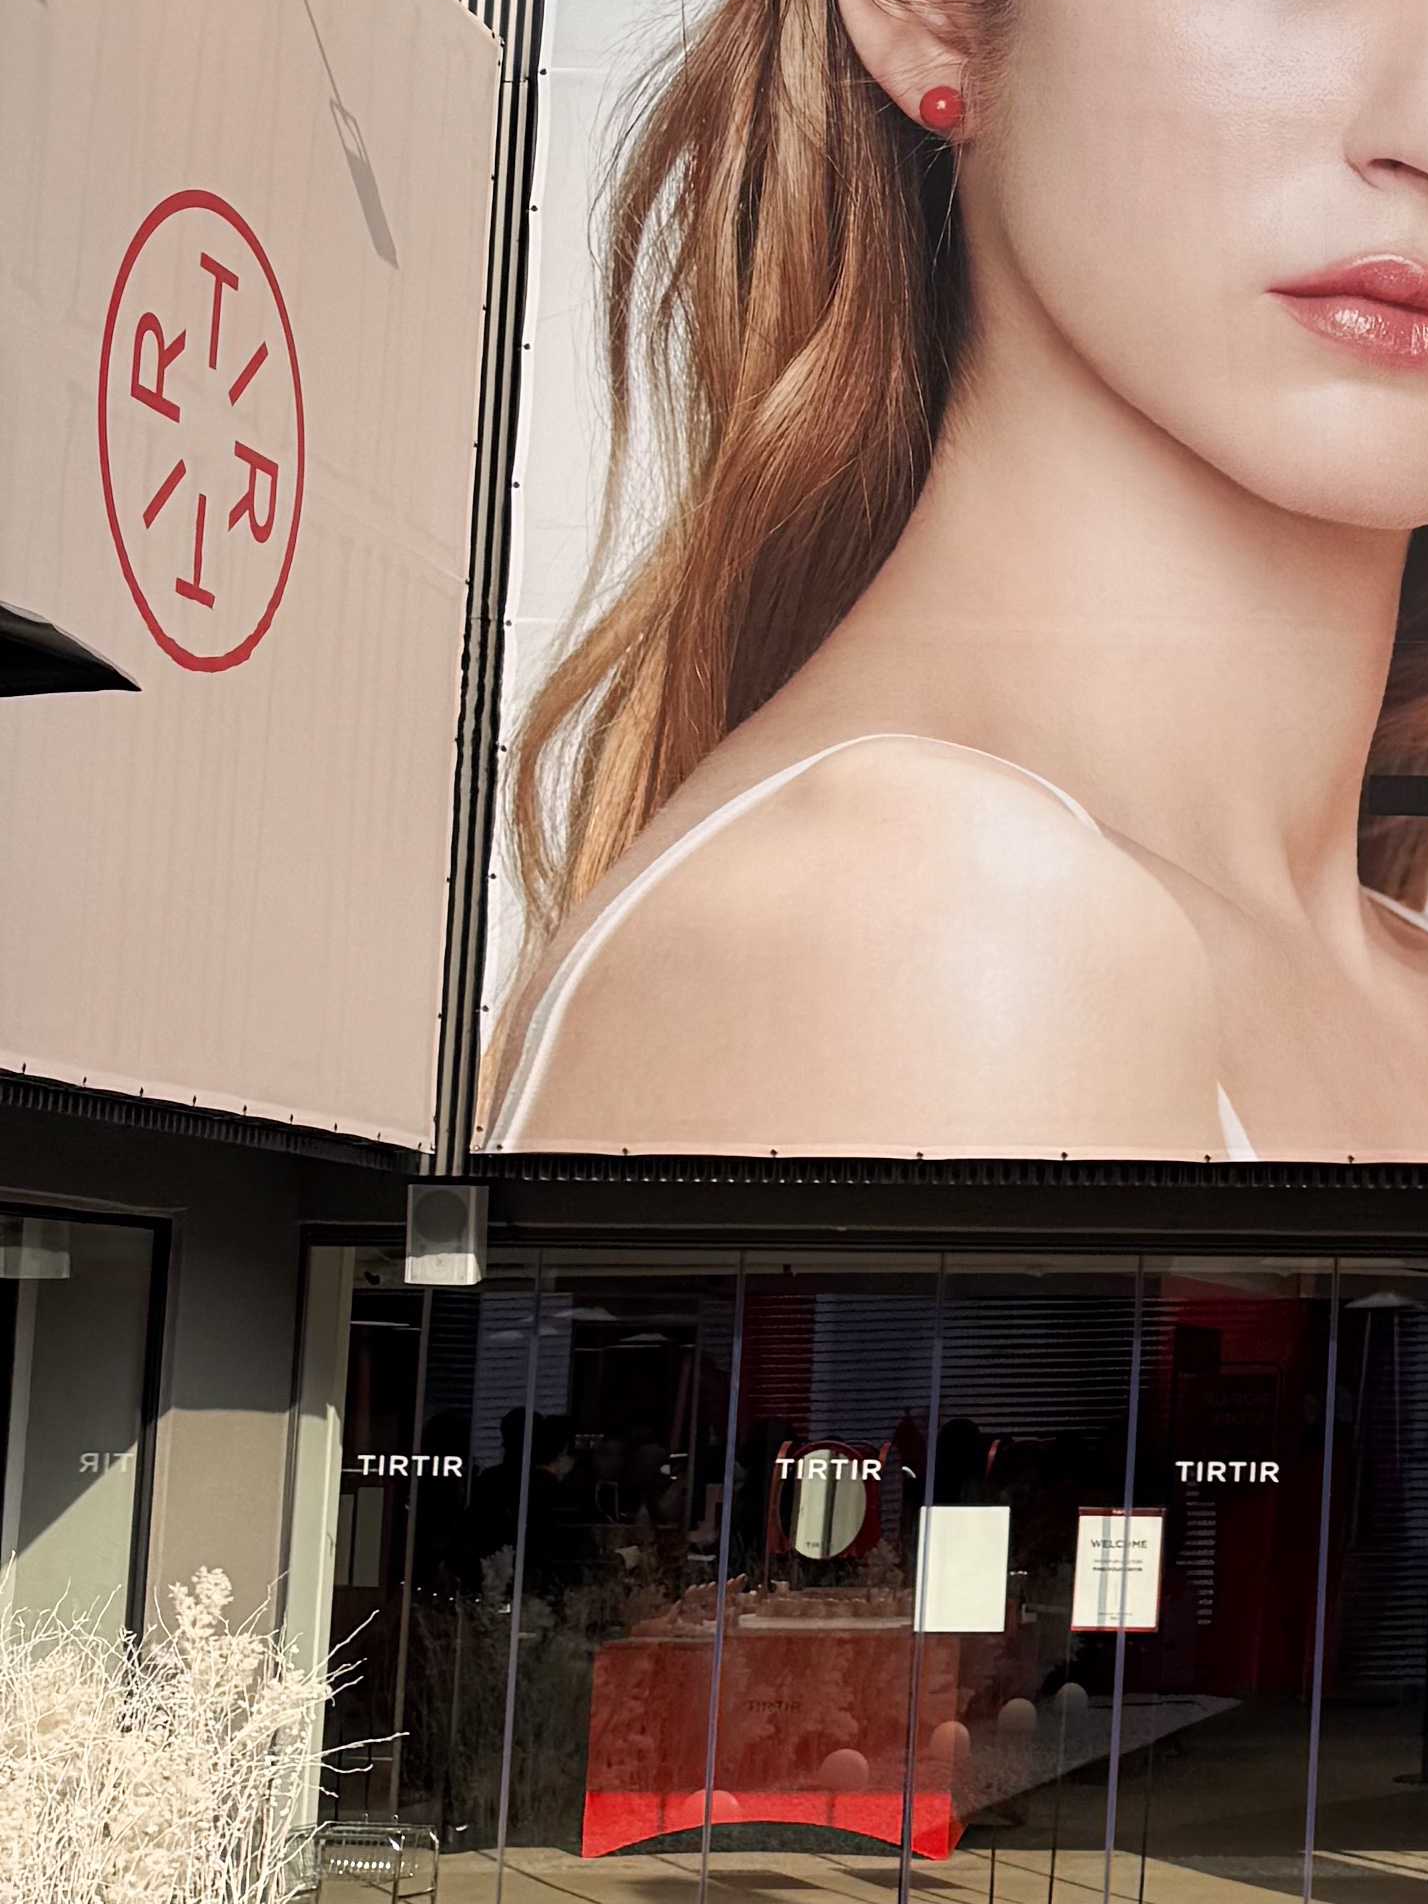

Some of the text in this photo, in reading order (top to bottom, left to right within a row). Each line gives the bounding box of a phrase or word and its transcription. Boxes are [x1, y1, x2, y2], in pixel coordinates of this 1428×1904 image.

[357, 1454, 464, 1477] TIRTIR
[775, 1458, 882, 1481] TIRTIR
[1175, 1460, 1280, 1483] TIRTIR
[1091, 1539, 1148, 1549] WELCME
